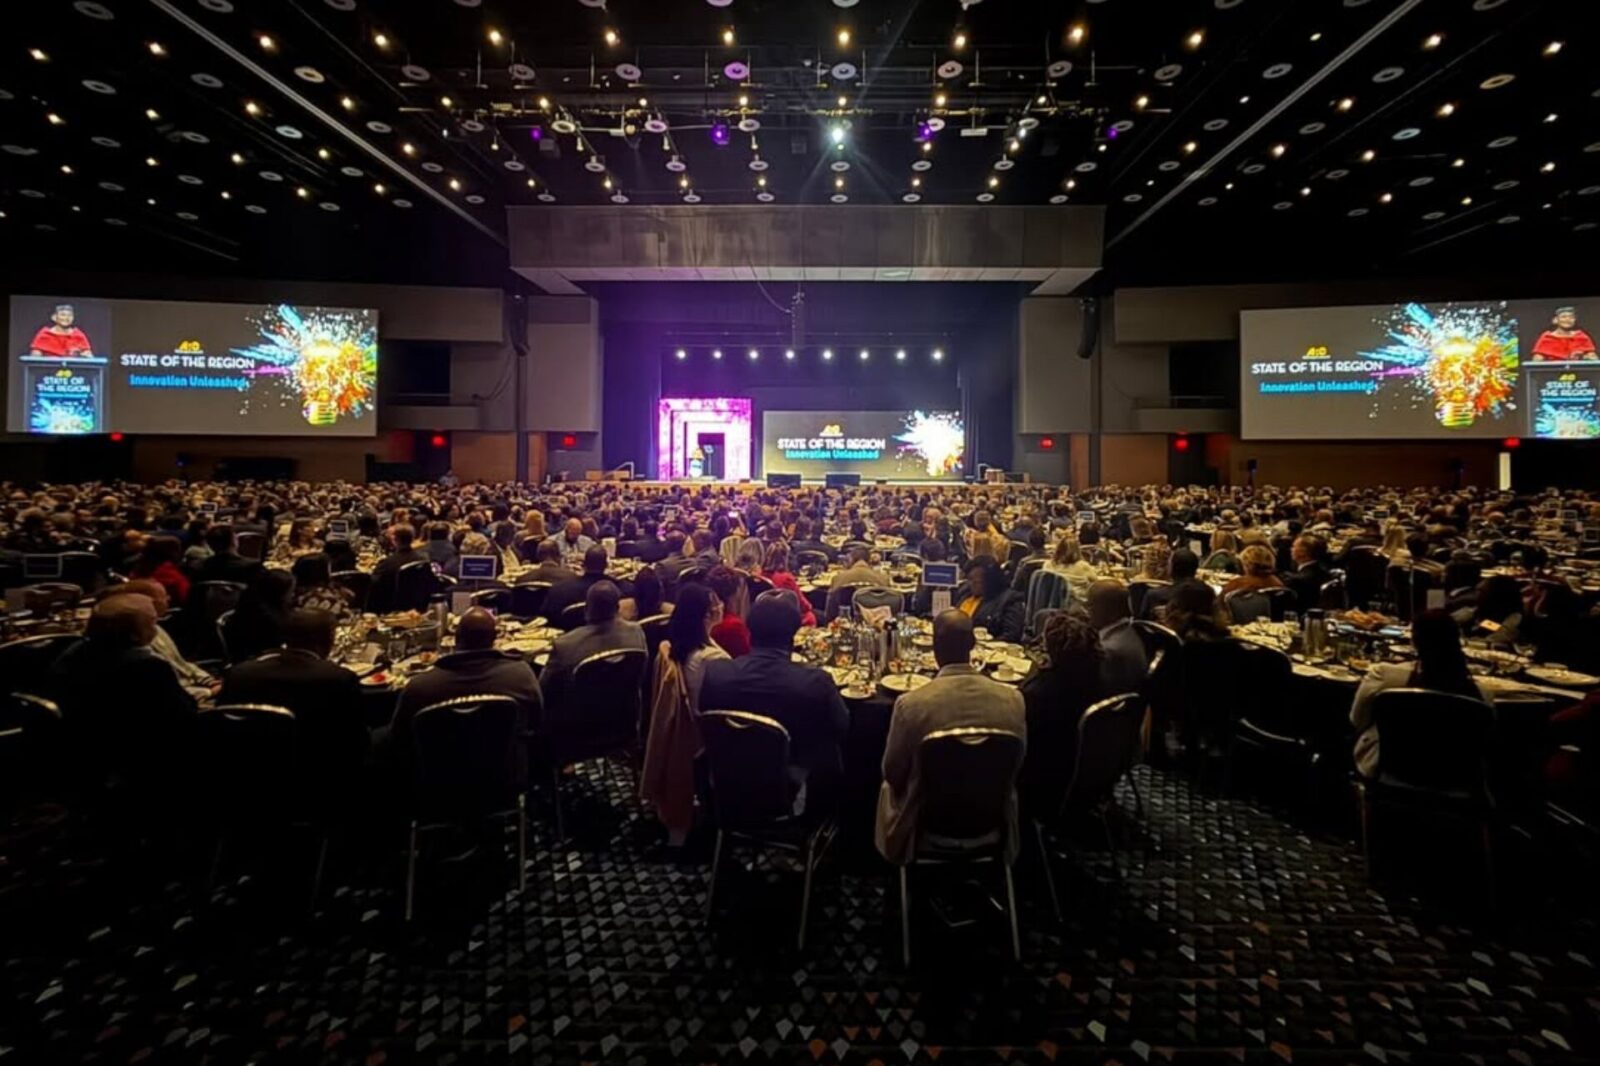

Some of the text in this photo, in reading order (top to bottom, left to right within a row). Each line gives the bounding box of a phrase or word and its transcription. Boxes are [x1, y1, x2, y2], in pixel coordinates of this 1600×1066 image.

[120, 354, 254, 369] STATE OF THE REGION
[1252, 360, 1383, 374] STATE OF THE REGION
[43, 376, 68, 385] STATE
[130, 374, 188, 386] Innovation
[56, 384, 90, 392] REGION
[1260, 382, 1316, 392] Innovation
[777, 438, 886, 450] STATE OF THE REGION
